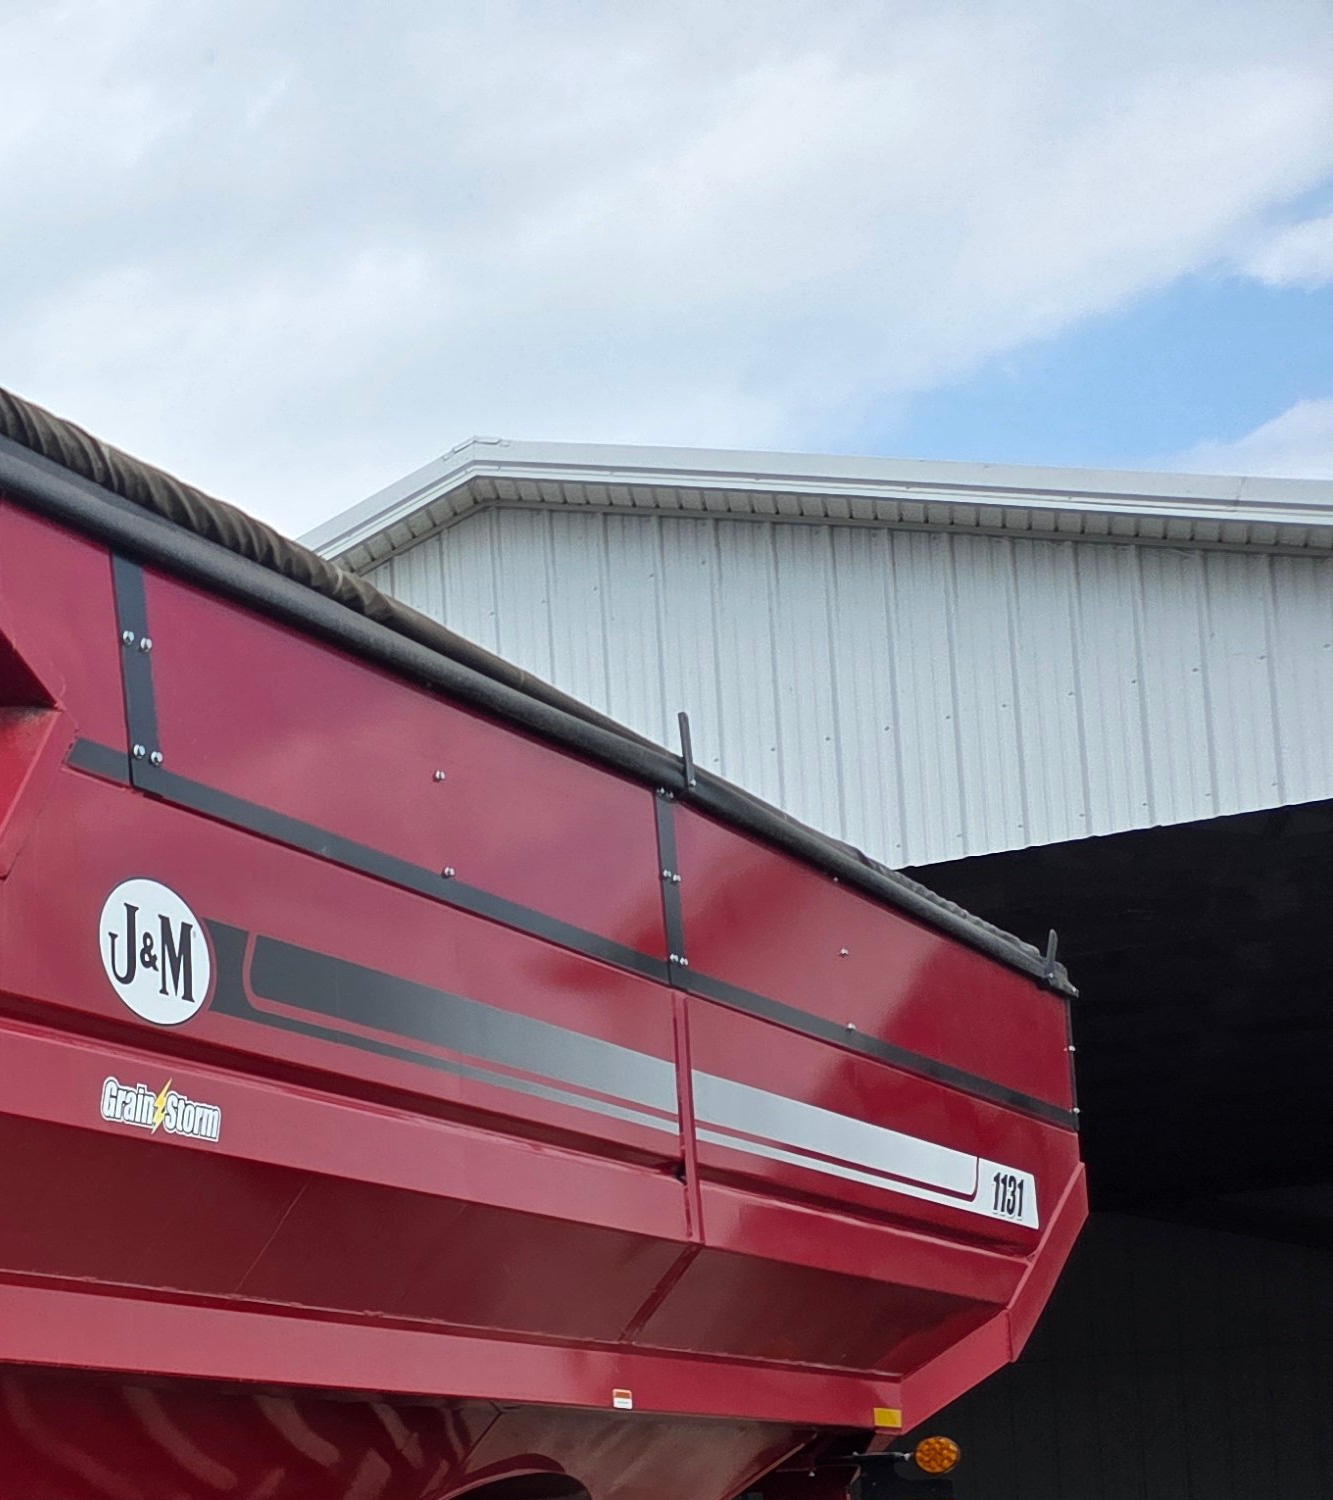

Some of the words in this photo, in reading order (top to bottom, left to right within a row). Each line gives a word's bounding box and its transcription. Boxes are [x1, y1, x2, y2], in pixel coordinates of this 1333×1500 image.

[108, 902, 196, 1003] J&M
[102, 1077, 156, 1129] Grain
[163, 1090, 221, 1142] Storm
[993, 1172, 1025, 1217] 1131
